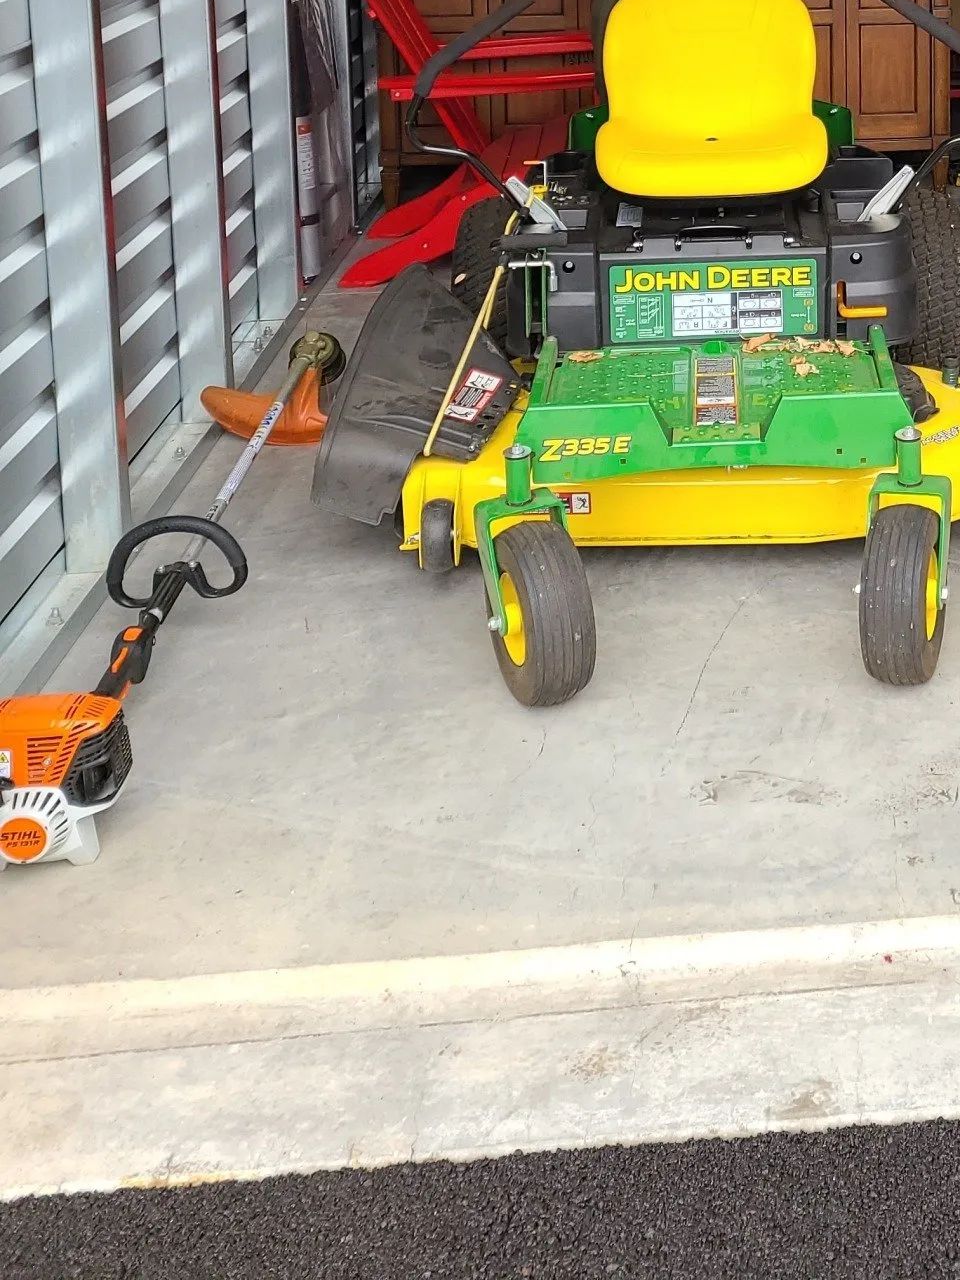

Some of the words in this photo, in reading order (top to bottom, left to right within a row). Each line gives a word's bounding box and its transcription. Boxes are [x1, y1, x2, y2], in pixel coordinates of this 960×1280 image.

[615, 269, 700, 294] JOHN
[707, 265, 812, 290] DEERE
[0, 830, 41, 841] STIHL
